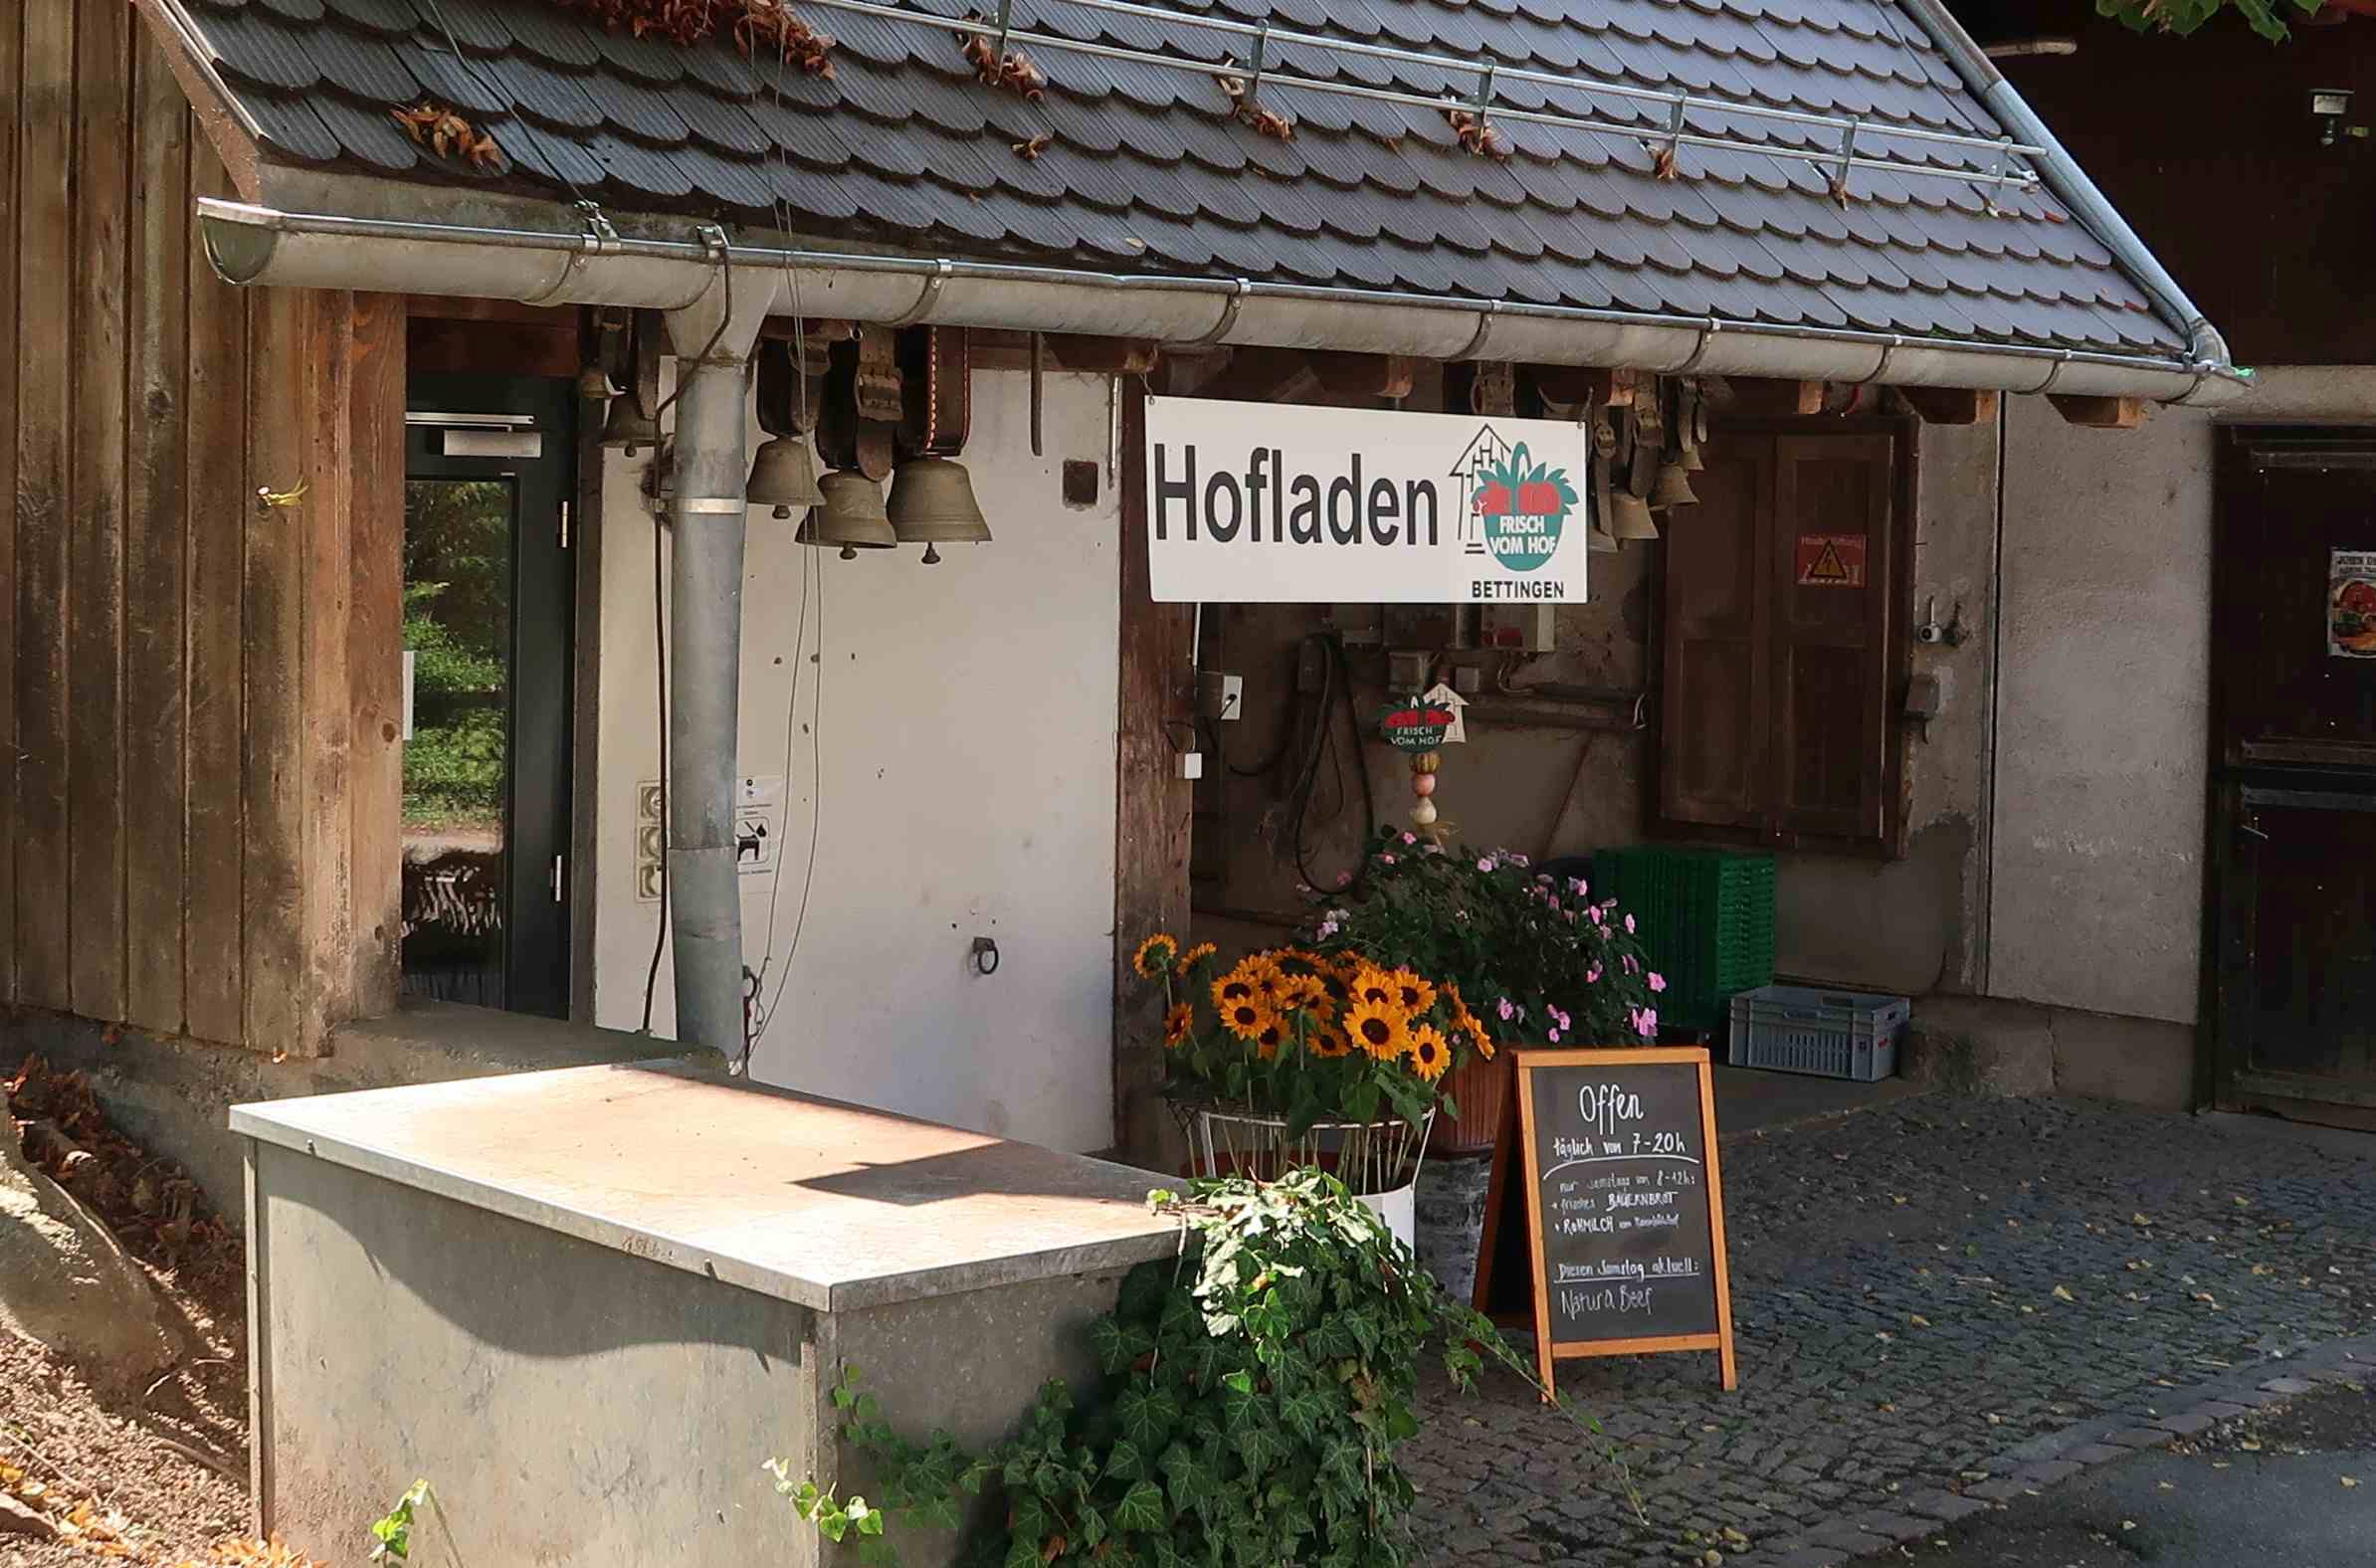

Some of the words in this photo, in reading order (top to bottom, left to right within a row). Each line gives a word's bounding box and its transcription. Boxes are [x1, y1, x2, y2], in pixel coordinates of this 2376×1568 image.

[1154, 444, 1438, 546] Hofladen
[1500, 515, 1544, 534] FRISCH
[1490, 536, 1523, 554] VOM
[1528, 536, 1556, 554] HOF
[1473, 580, 1564, 598] BETTINGEN
[1391, 736, 1416, 746] VOM
[1419, 735, 1442, 745] HOF
[1397, 726, 1433, 736] FRISCH
[1579, 1083, 1644, 1135] Offen
[1553, 1137, 1594, 1162] täglich
[1559, 1263, 1594, 1279] Diesen
[1598, 1258, 1645, 1281] Samstag
[1619, 1284, 1654, 1315] Beef
